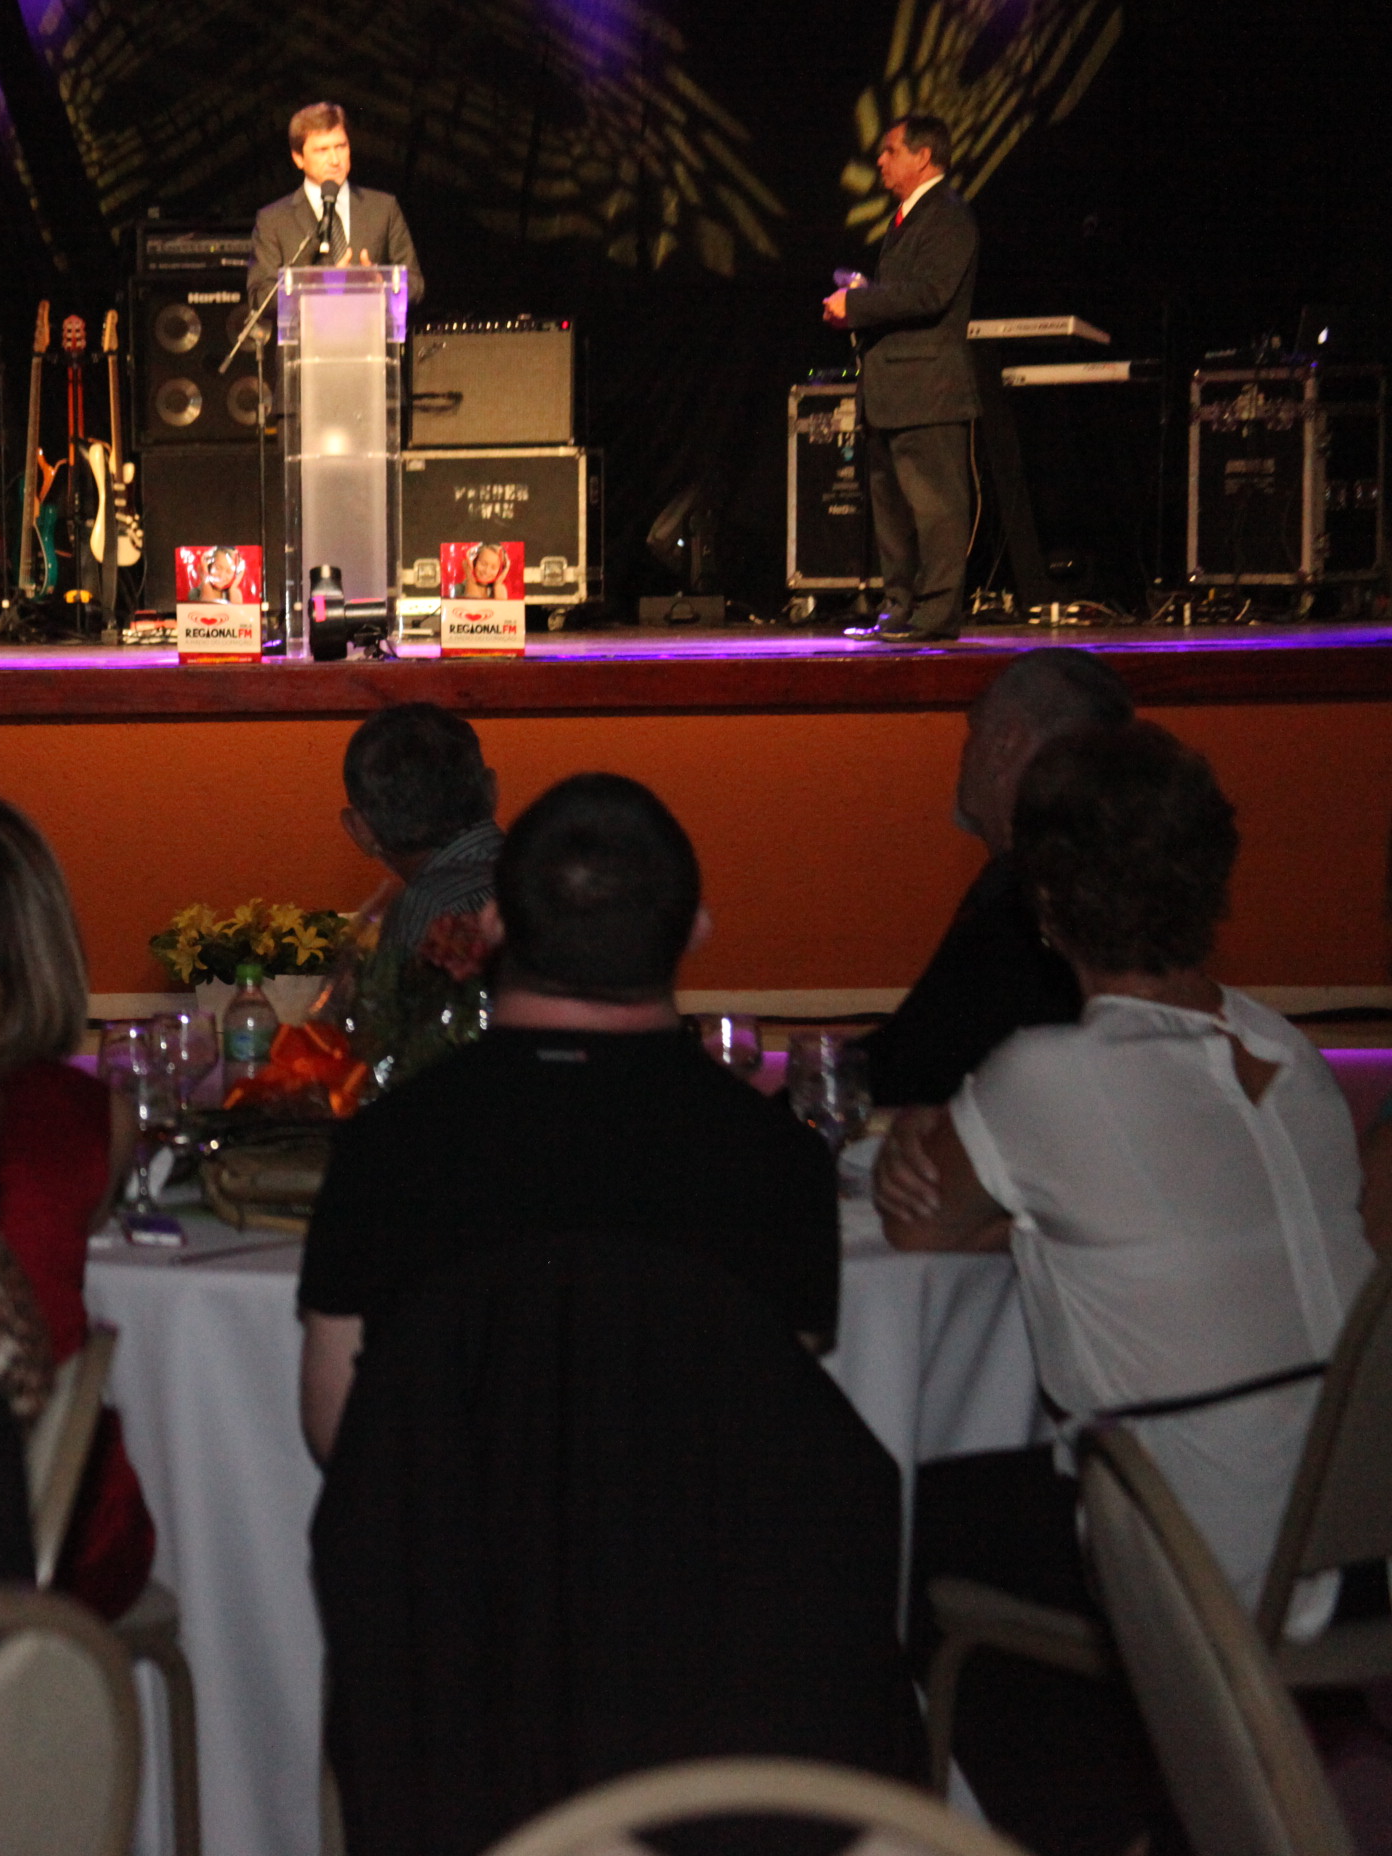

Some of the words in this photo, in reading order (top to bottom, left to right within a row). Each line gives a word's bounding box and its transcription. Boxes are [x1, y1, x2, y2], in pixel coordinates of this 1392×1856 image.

[188, 292, 241, 303] Hartke
[185, 628, 237, 639] REGIONAL
[238, 628, 252, 639] FM
[449, 624, 501, 635] REGIONAL
[502, 624, 517, 635] FM
